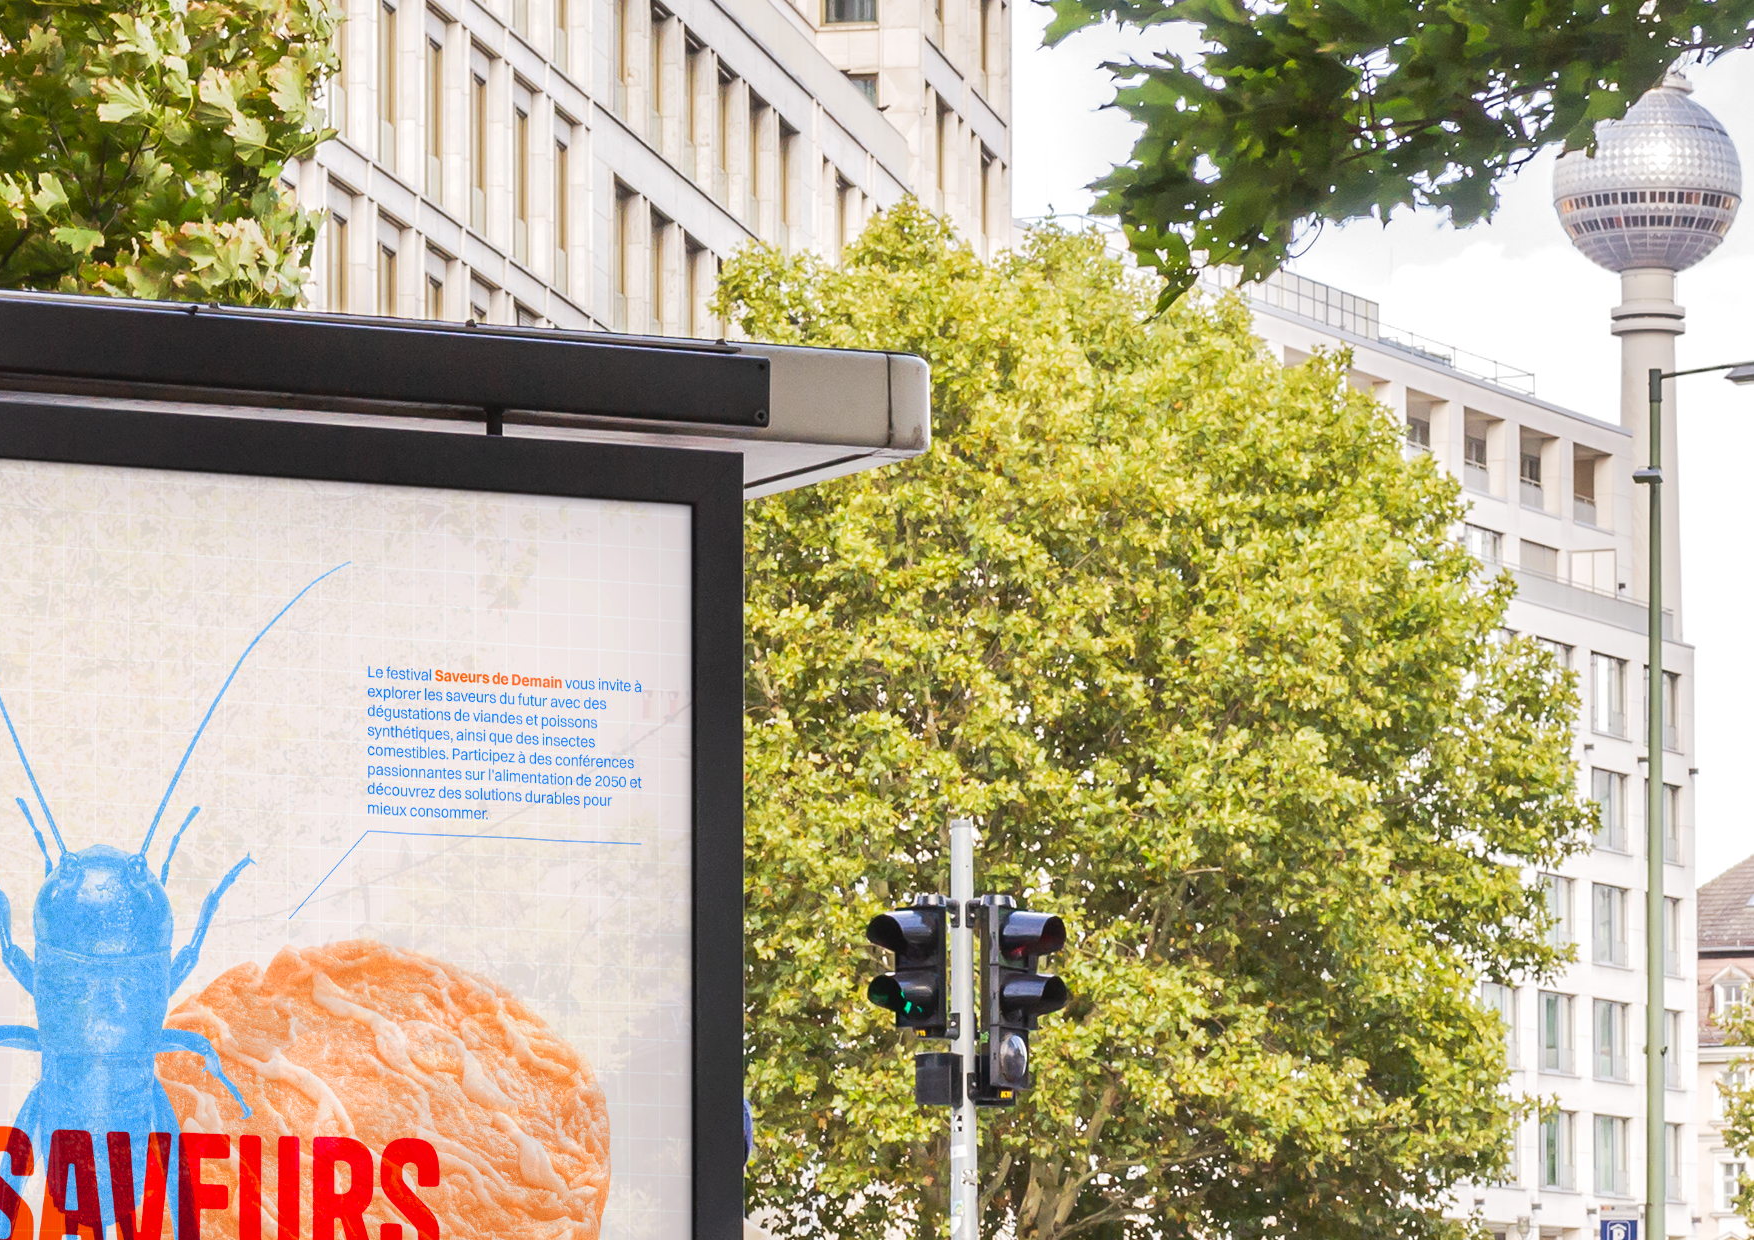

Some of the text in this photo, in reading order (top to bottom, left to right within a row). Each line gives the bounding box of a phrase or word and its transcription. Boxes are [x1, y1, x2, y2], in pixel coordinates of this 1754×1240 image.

[368, 666, 641, 692] Le festival Saveurs de Demain vous invite à
[368, 686, 606, 709] explorer les saveurs du futur avec des
[368, 705, 597, 729] dégustations de viandes et poissons
[368, 725, 595, 748] synthétiques, ainsi que des insectes
[368, 746, 634, 769] comestibles. Participez à des conférences
[368, 765, 642, 788] passionnantes sur l'alimentation de 2050 et
[368, 782, 612, 809] découvrez des solutions durables pour
[368, 804, 488, 819] mieux consommer.
